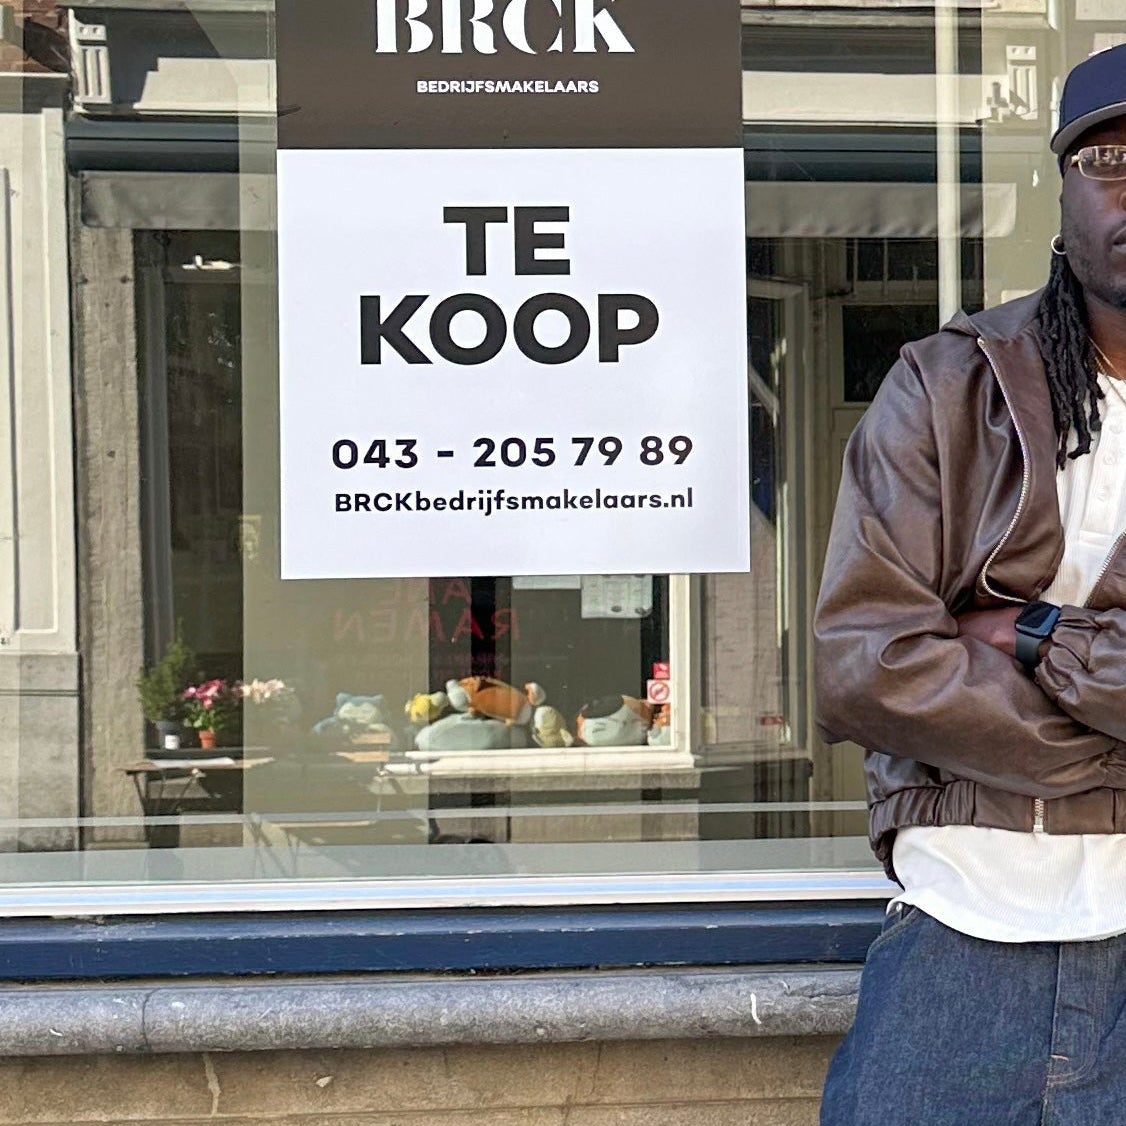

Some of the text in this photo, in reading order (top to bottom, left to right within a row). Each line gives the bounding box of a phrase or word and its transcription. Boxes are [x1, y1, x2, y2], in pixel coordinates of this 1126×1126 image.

[376, 0, 635, 54] BRCK
[416, 80, 599, 93] BEDRIJFSMAKELAARS
[443, 206, 570, 276] TE
[360, 293, 659, 365] KOOP
[332, 439, 418, 469] 043
[473, 438, 556, 468] 205
[572, 437, 623, 467] 79
[640, 436, 693, 466] 89
[335, 488, 693, 516] BRCKbedrijfsmakelaars.nl
